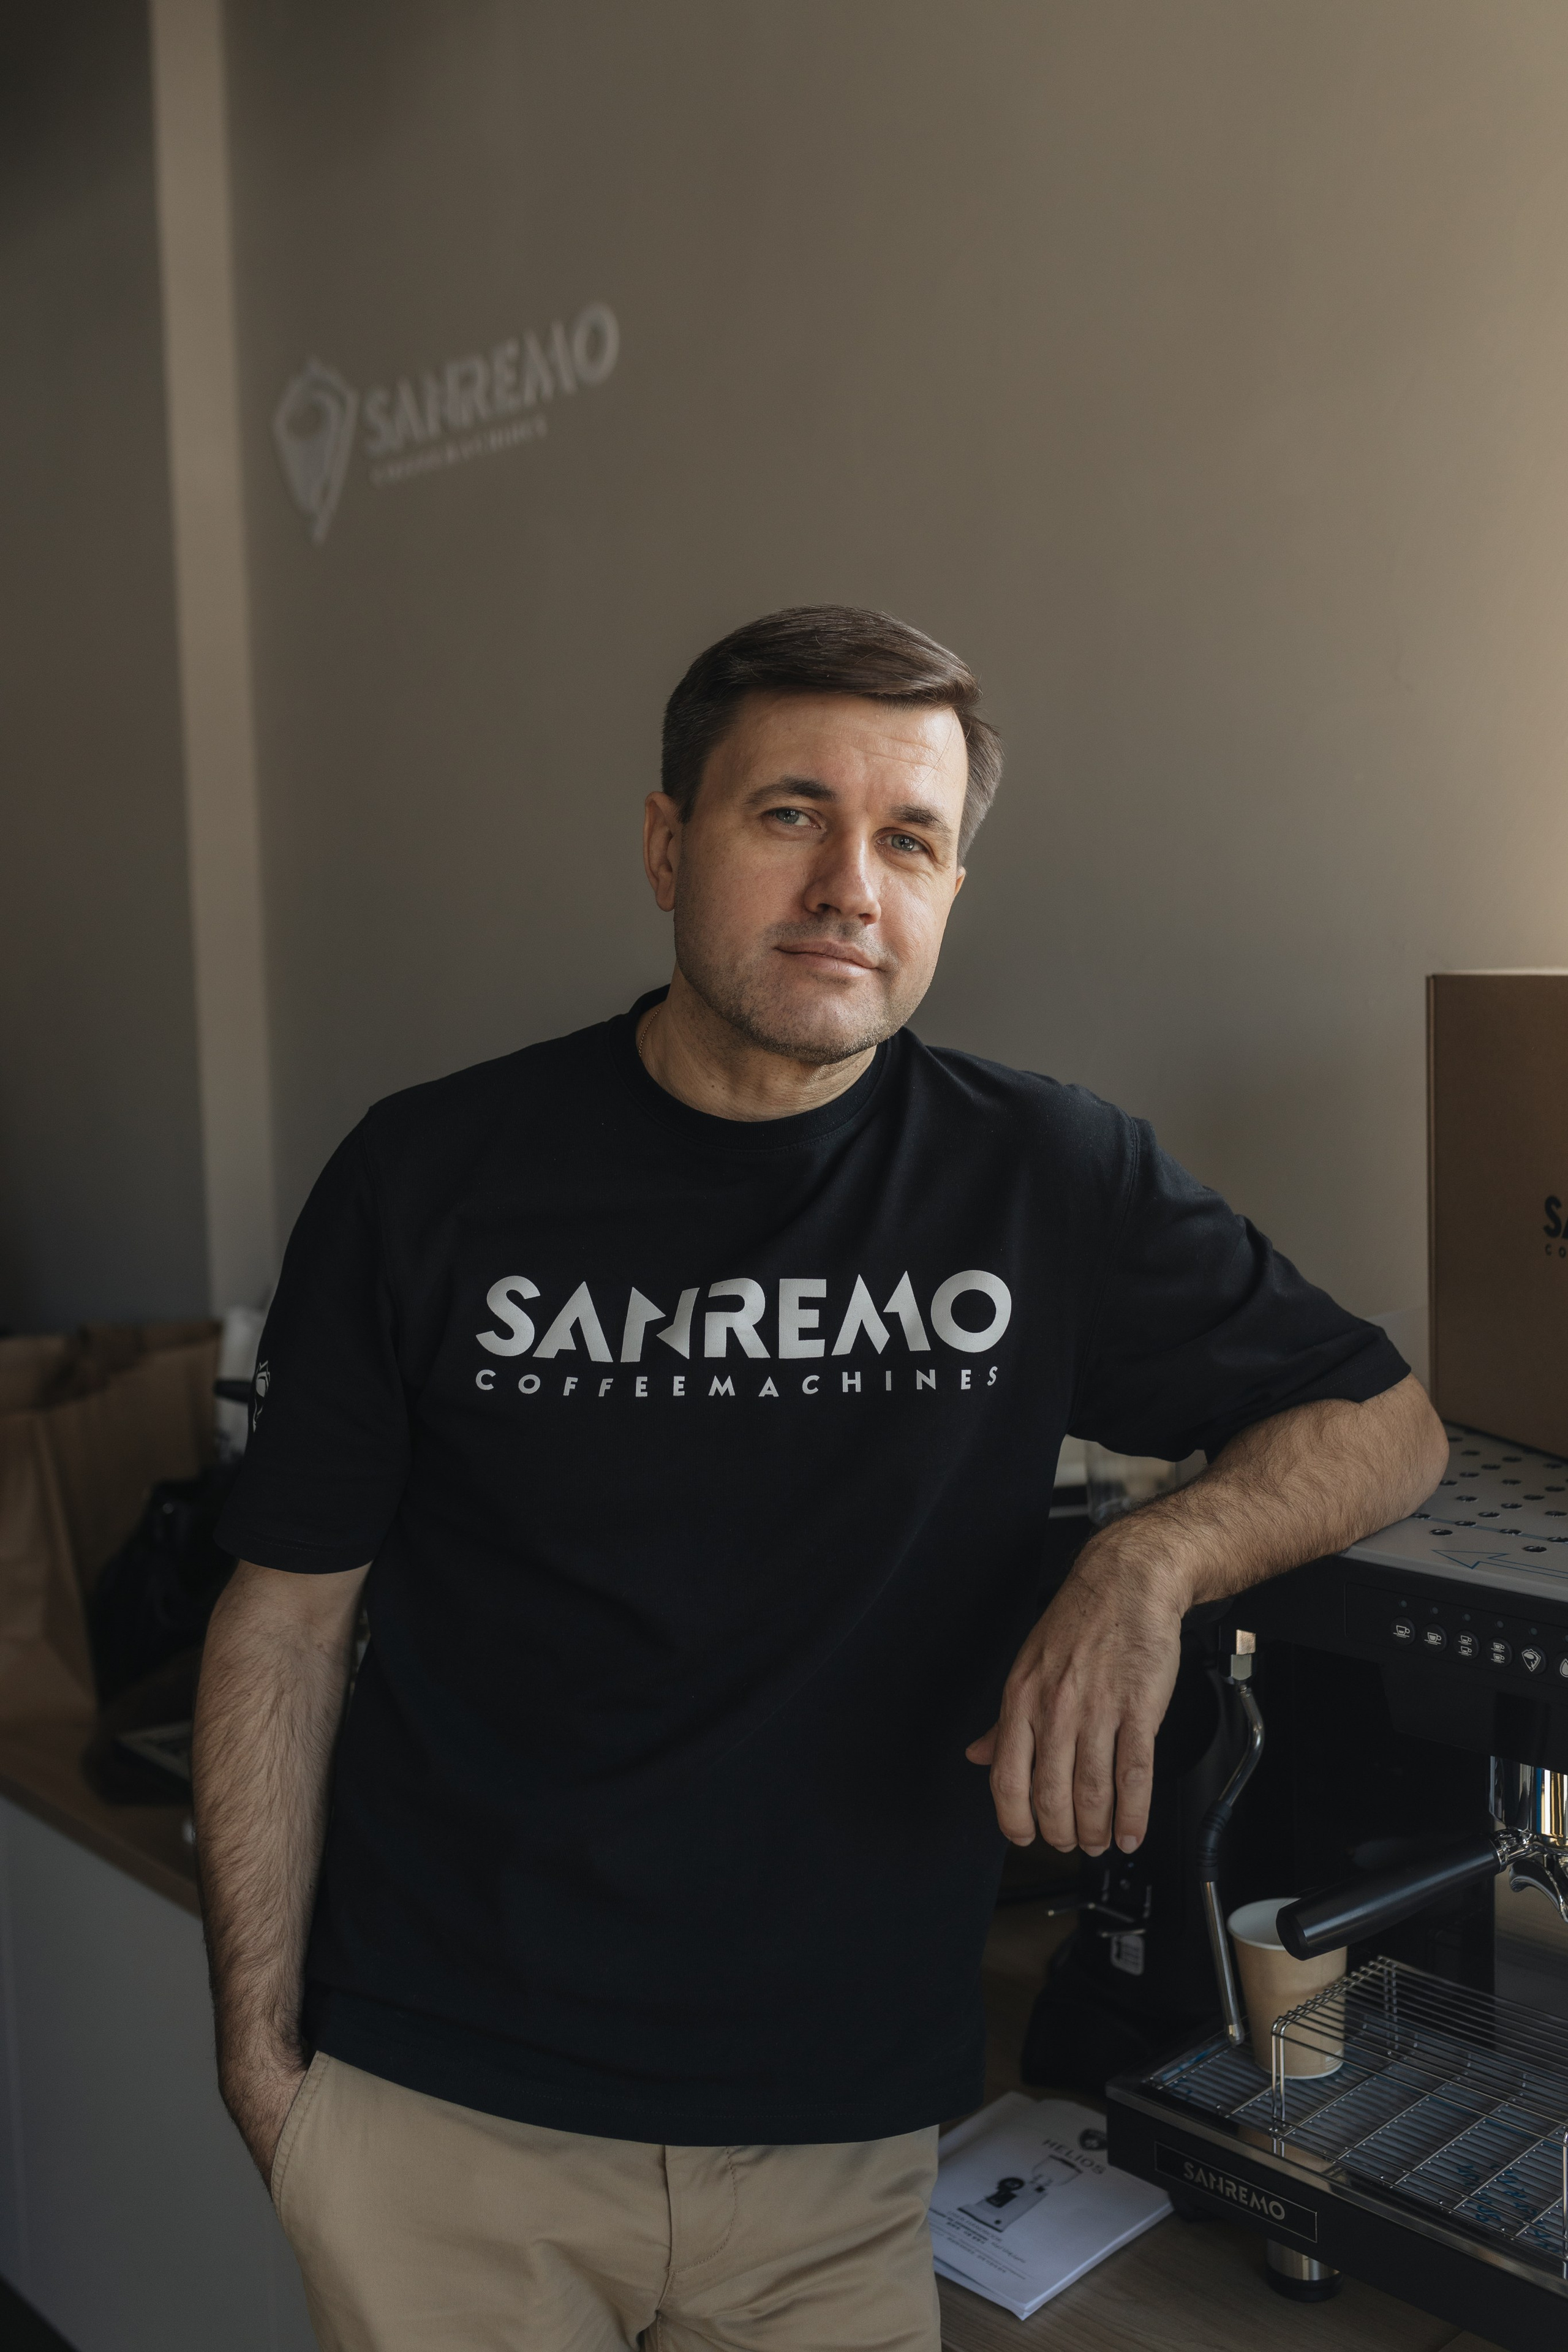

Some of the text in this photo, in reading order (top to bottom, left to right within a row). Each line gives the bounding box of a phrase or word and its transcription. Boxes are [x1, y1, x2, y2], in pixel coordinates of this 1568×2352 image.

[365, 301, 620, 458] SANREMO
[475, 1269, 1012, 1363] SANREMO
[475, 1366, 999, 1397] COFFEEMACHINES
[1042, 2139, 1106, 2174] HELIOS
[1183, 2162, 1286, 2220] SANREMO
